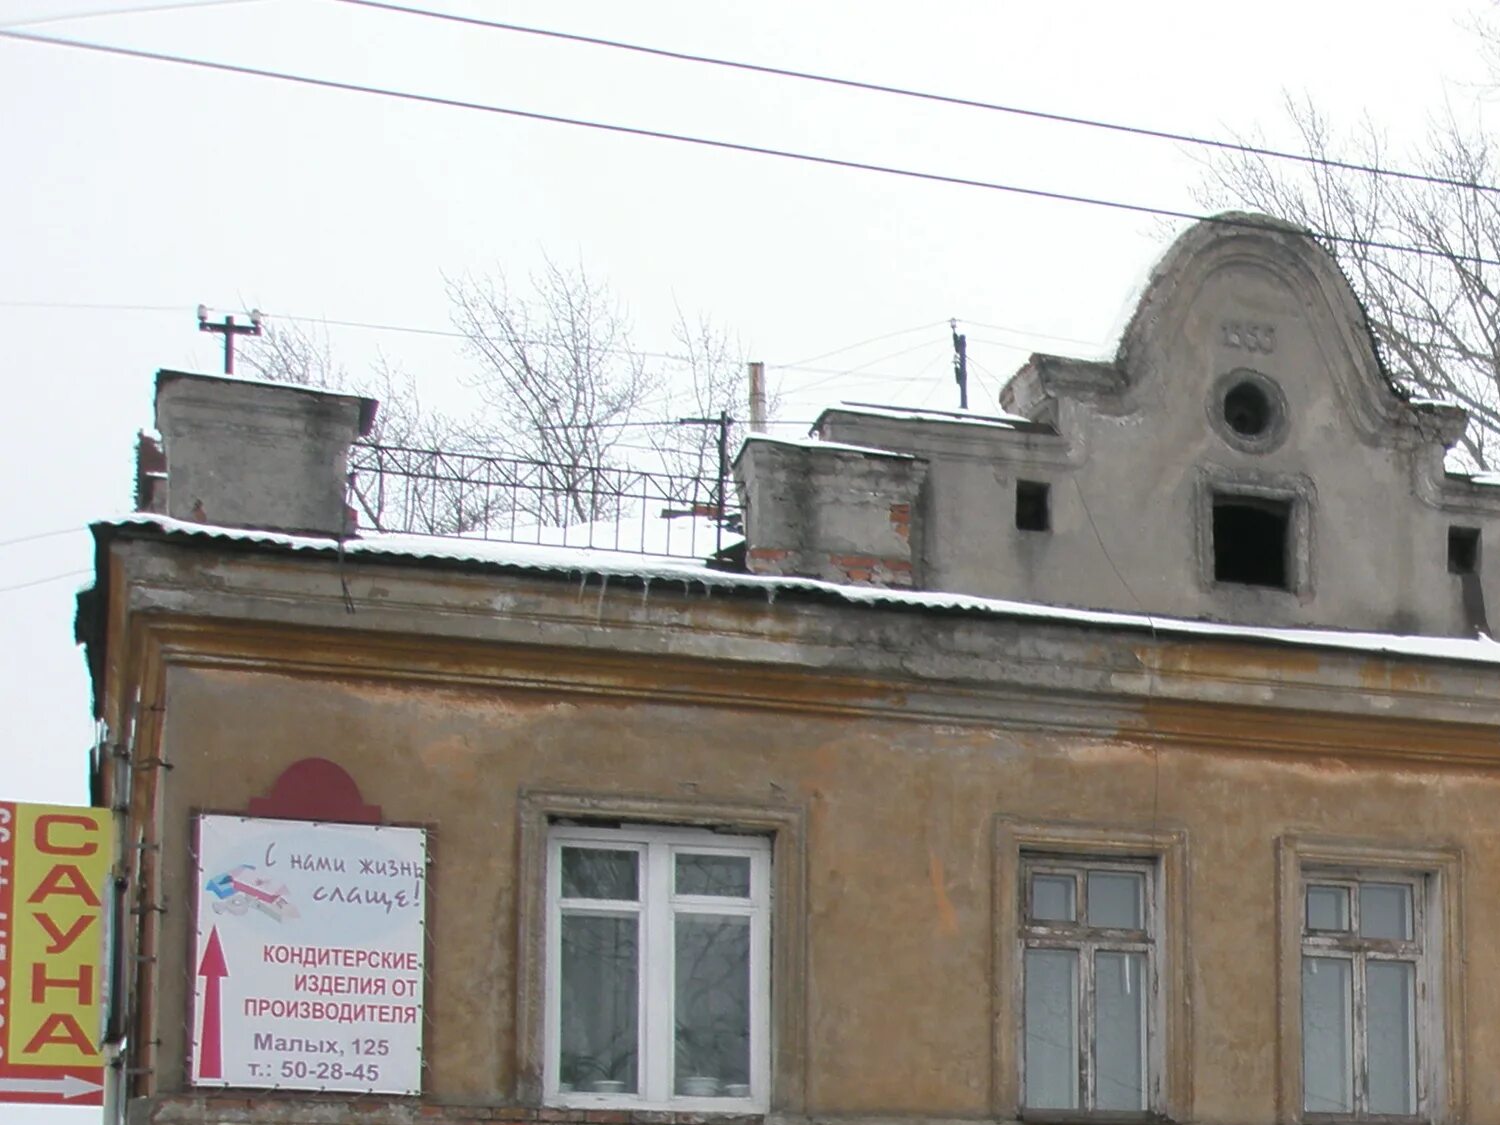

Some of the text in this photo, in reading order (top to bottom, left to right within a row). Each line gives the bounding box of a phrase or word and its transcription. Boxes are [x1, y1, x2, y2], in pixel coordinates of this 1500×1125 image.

[265, 842, 424, 879] С нами жизнь
[313, 880, 420, 915] слаще!
[22, 814, 102, 1056] САУНА
[263, 945, 418, 970] КОНДИТЕРСКИЕ
[295, 974, 418, 997] ИЗДЕЛИЯ ОТ
[244, 998, 417, 1024] ПРОИЗВОДИТЕЛЯ
[253, 1033, 389, 1056] Малых, 125
[281, 1060, 379, 1081] 50-28-45
